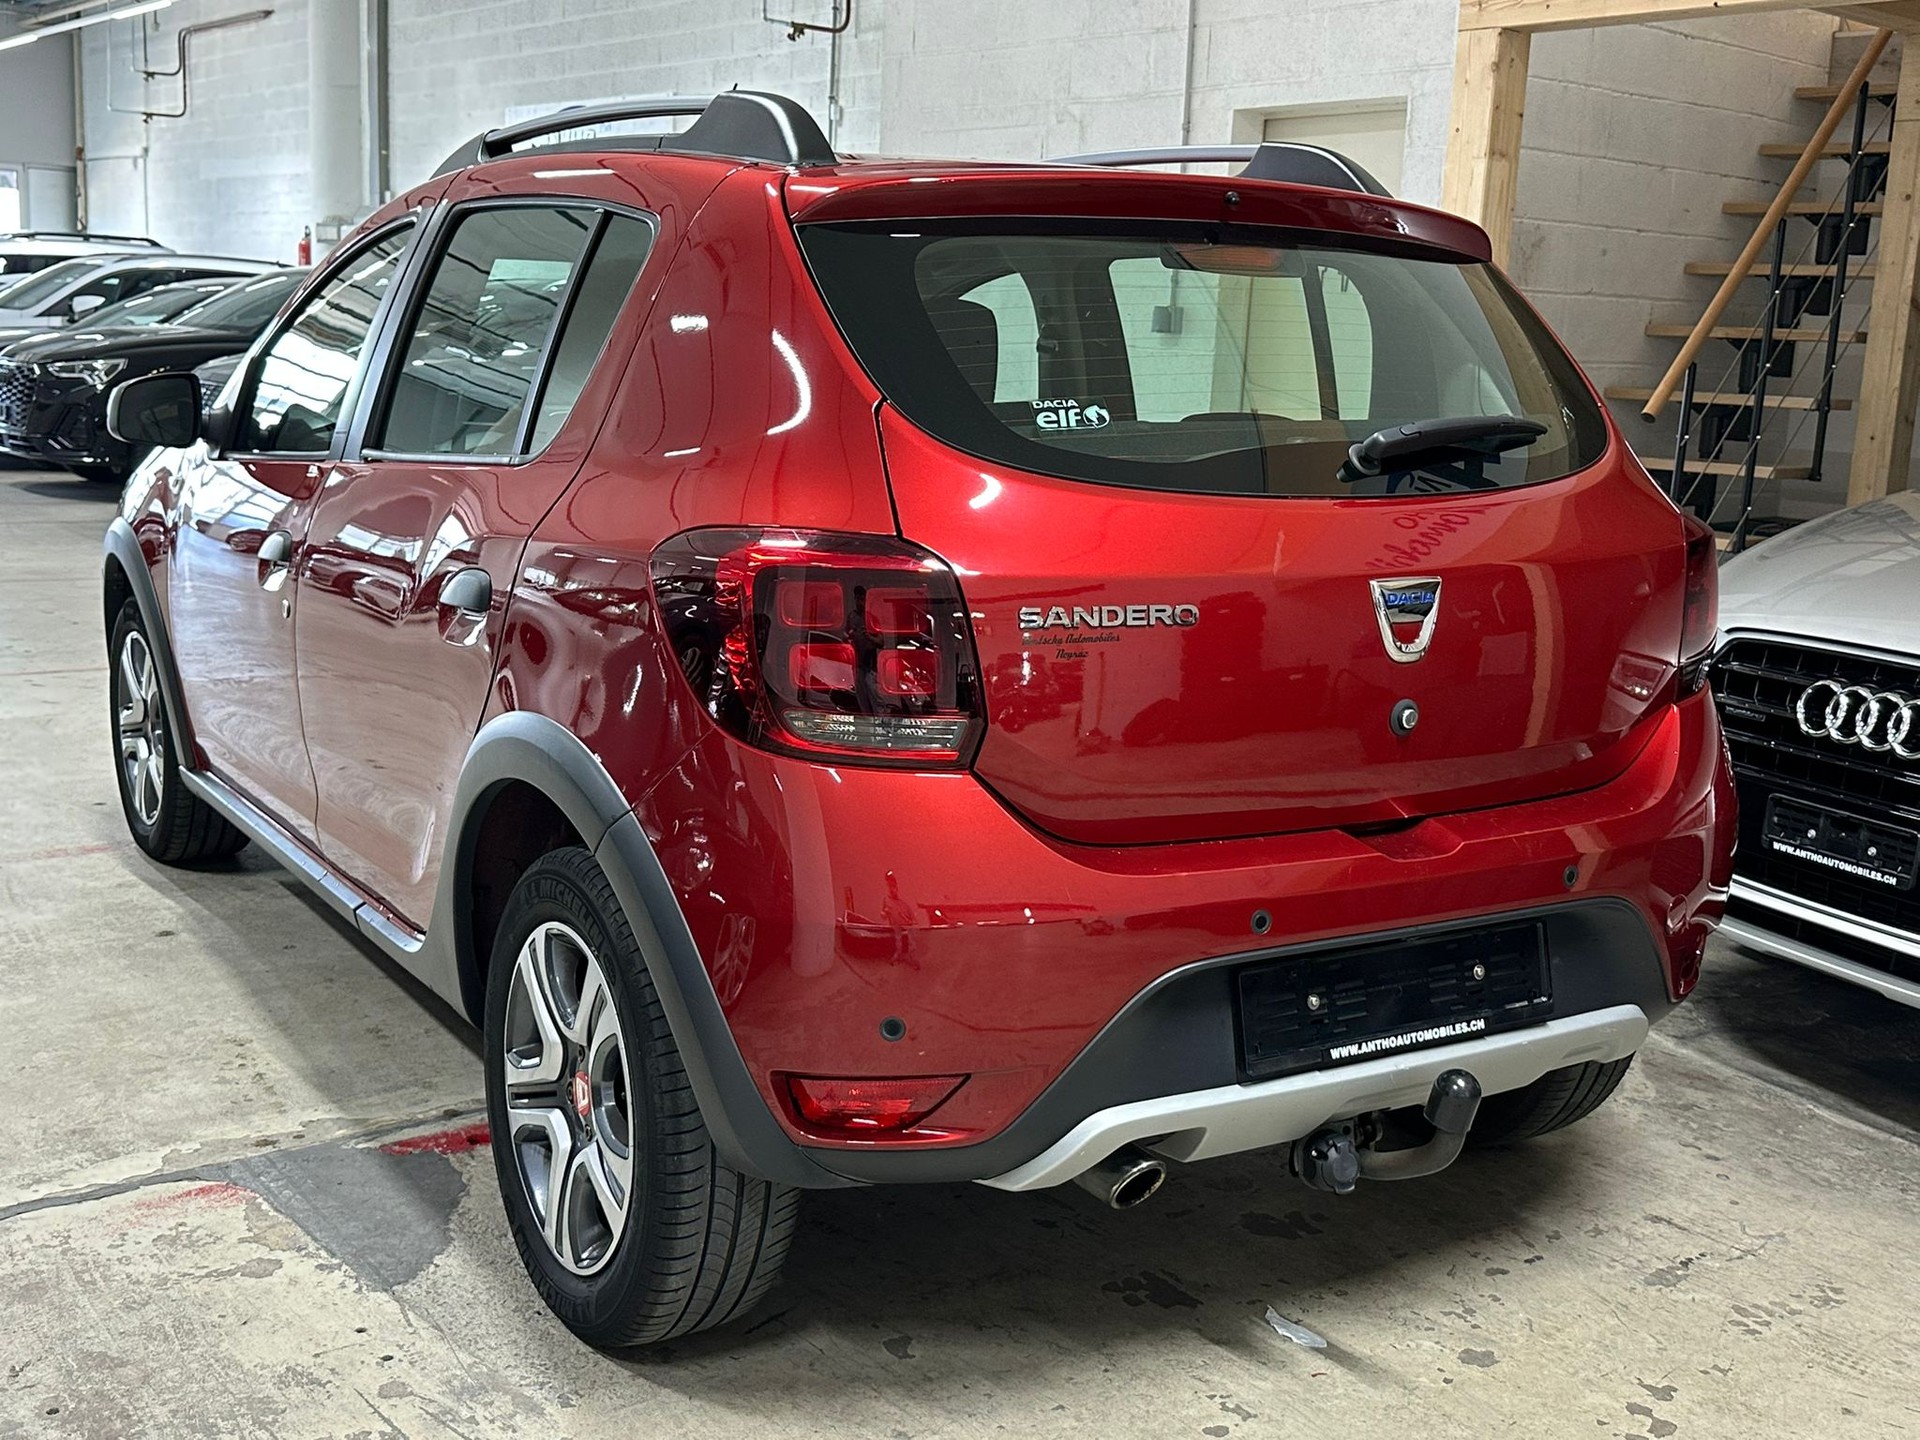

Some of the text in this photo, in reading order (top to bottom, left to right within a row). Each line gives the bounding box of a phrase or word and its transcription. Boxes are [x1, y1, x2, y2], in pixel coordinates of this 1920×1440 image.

[1032, 399, 1079, 409] DACIA
[1036, 408, 1081, 428] elf
[1387, 591, 1434, 605] DACIA
[1019, 604, 1200, 628] SANDERO
[1772, 840, 1897, 886] WWW.ANTHOAUTOMOBILES.CH
[540, 878, 605, 948] MICHELIN
[1330, 1018, 1485, 1060] WWW.ANTHOAUTOMOBILES.CH
